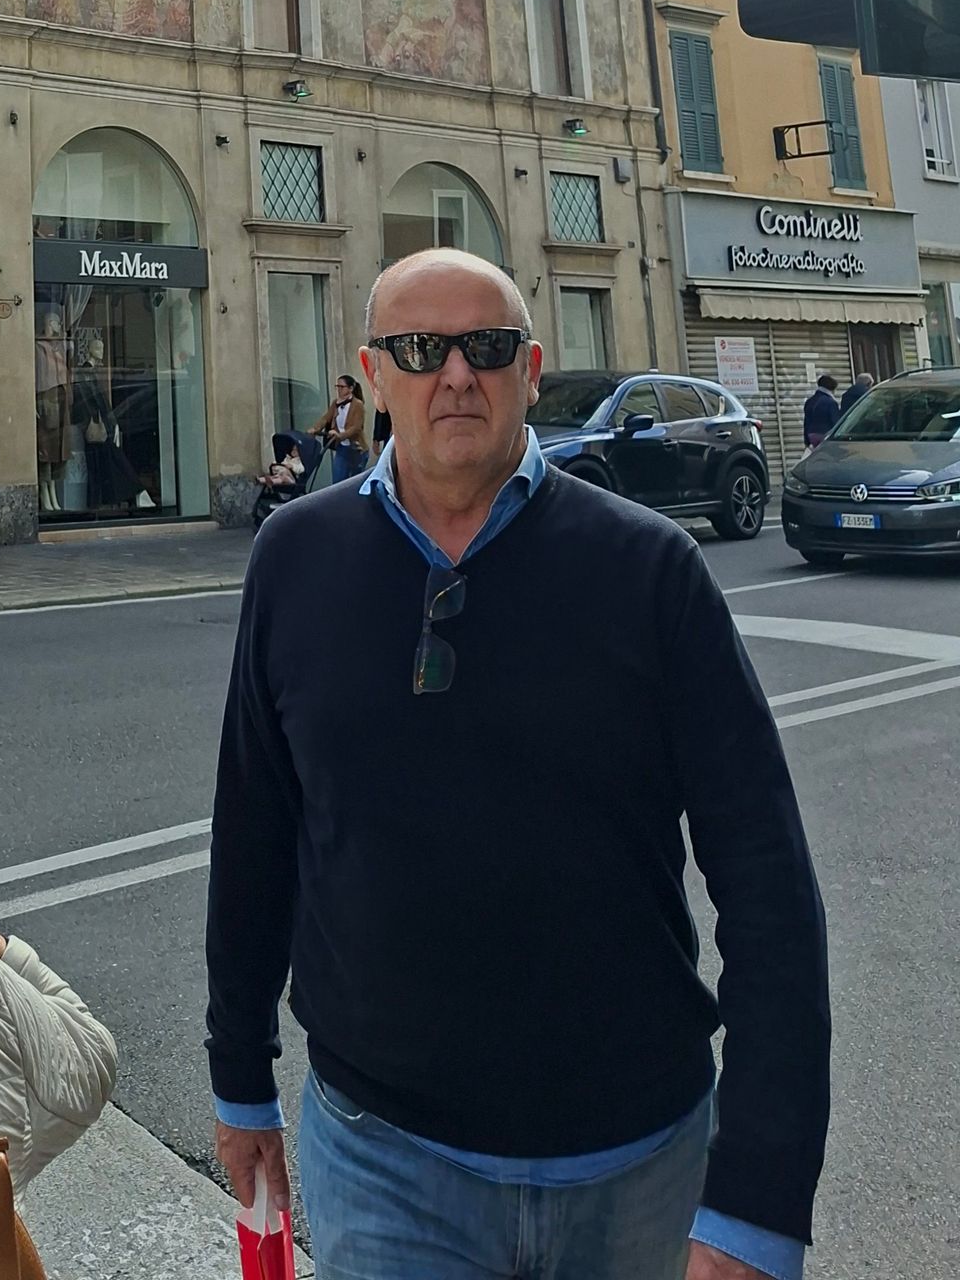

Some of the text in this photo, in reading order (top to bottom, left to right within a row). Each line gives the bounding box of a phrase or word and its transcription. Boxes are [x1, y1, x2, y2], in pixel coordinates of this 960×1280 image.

[758, 205, 864, 242] Cominelli
[79, 250, 169, 280] MaxMara
[730, 245, 866, 278] fotocineradiografia
